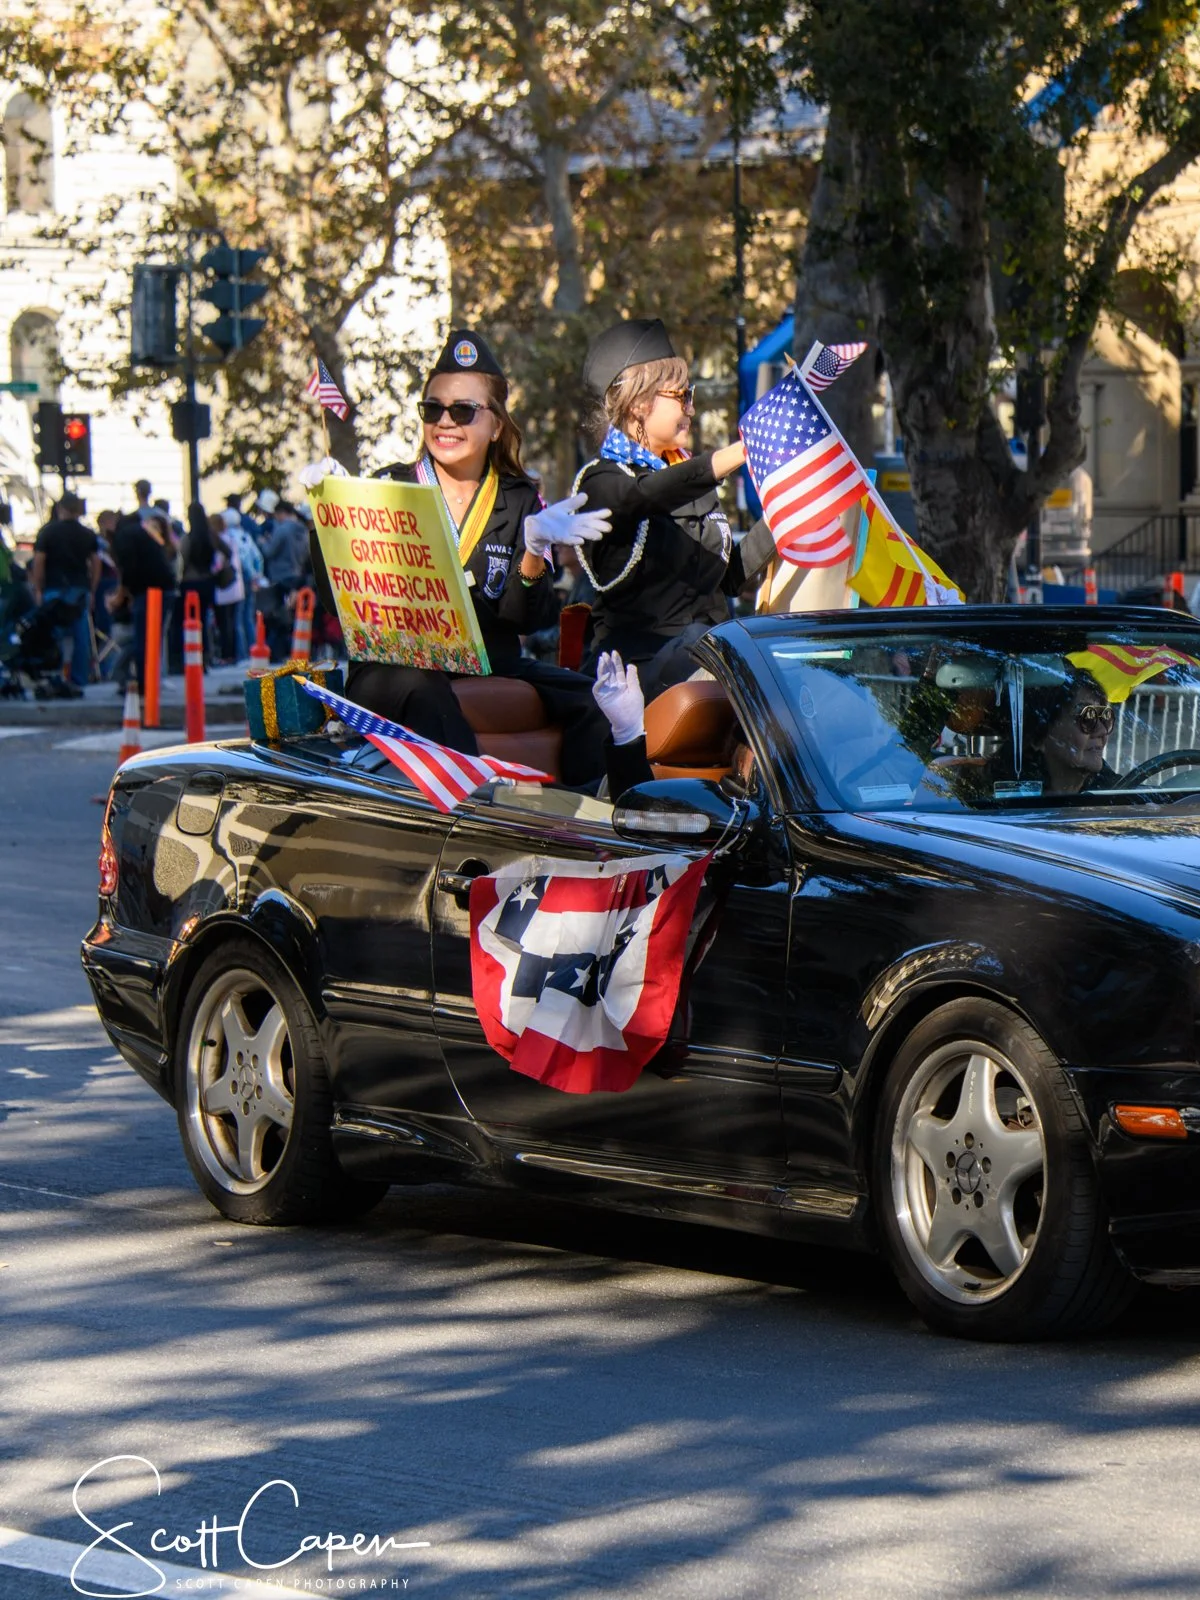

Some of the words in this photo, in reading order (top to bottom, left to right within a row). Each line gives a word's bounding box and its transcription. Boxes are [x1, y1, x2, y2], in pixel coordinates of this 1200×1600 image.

[316, 502, 349, 530] OUR
[349, 506, 422, 539] FOREVER
[485, 543, 507, 554] AVVA
[330, 567, 363, 595] FOR
[353, 600, 460, 639] VETERANS!
